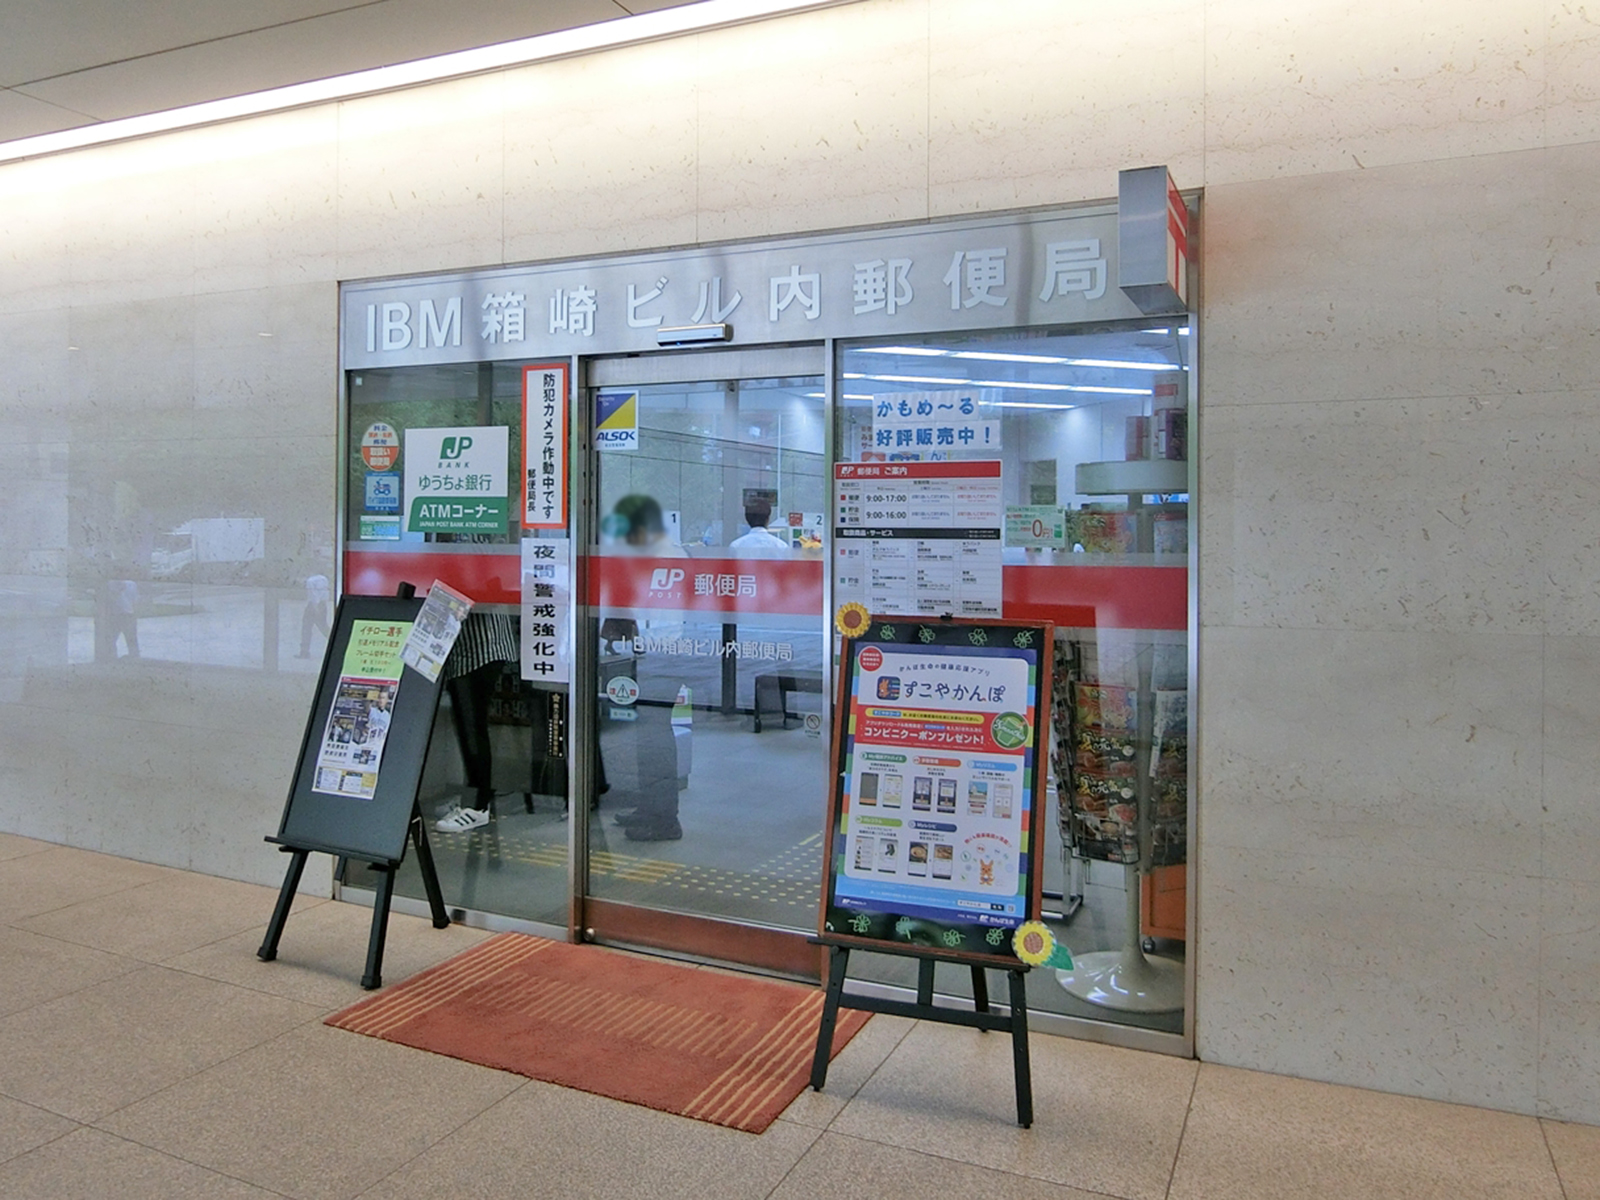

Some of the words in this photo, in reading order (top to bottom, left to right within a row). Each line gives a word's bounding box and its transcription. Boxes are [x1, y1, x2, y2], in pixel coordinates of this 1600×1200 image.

[595, 430, 636, 442] ALSOK
[542, 373, 556, 520] 防犯カメラ作動中です
[437, 461, 471, 469] BANK
[418, 473, 493, 492] ゆうちょ銀行
[865, 494, 907, 503] 9:00-17:00
[419, 503, 499, 519] ATMコーナー
[865, 511, 907, 520] 9:00-16:00
[671, 513, 677, 523] 1
[816, 515, 823, 526] 2
[694, 573, 757, 598] 郵便局
[648, 591, 682, 599] POST
[532, 545, 556, 676] 夜間警戒強化中
[903, 680, 1006, 704] すこやかんぽ
